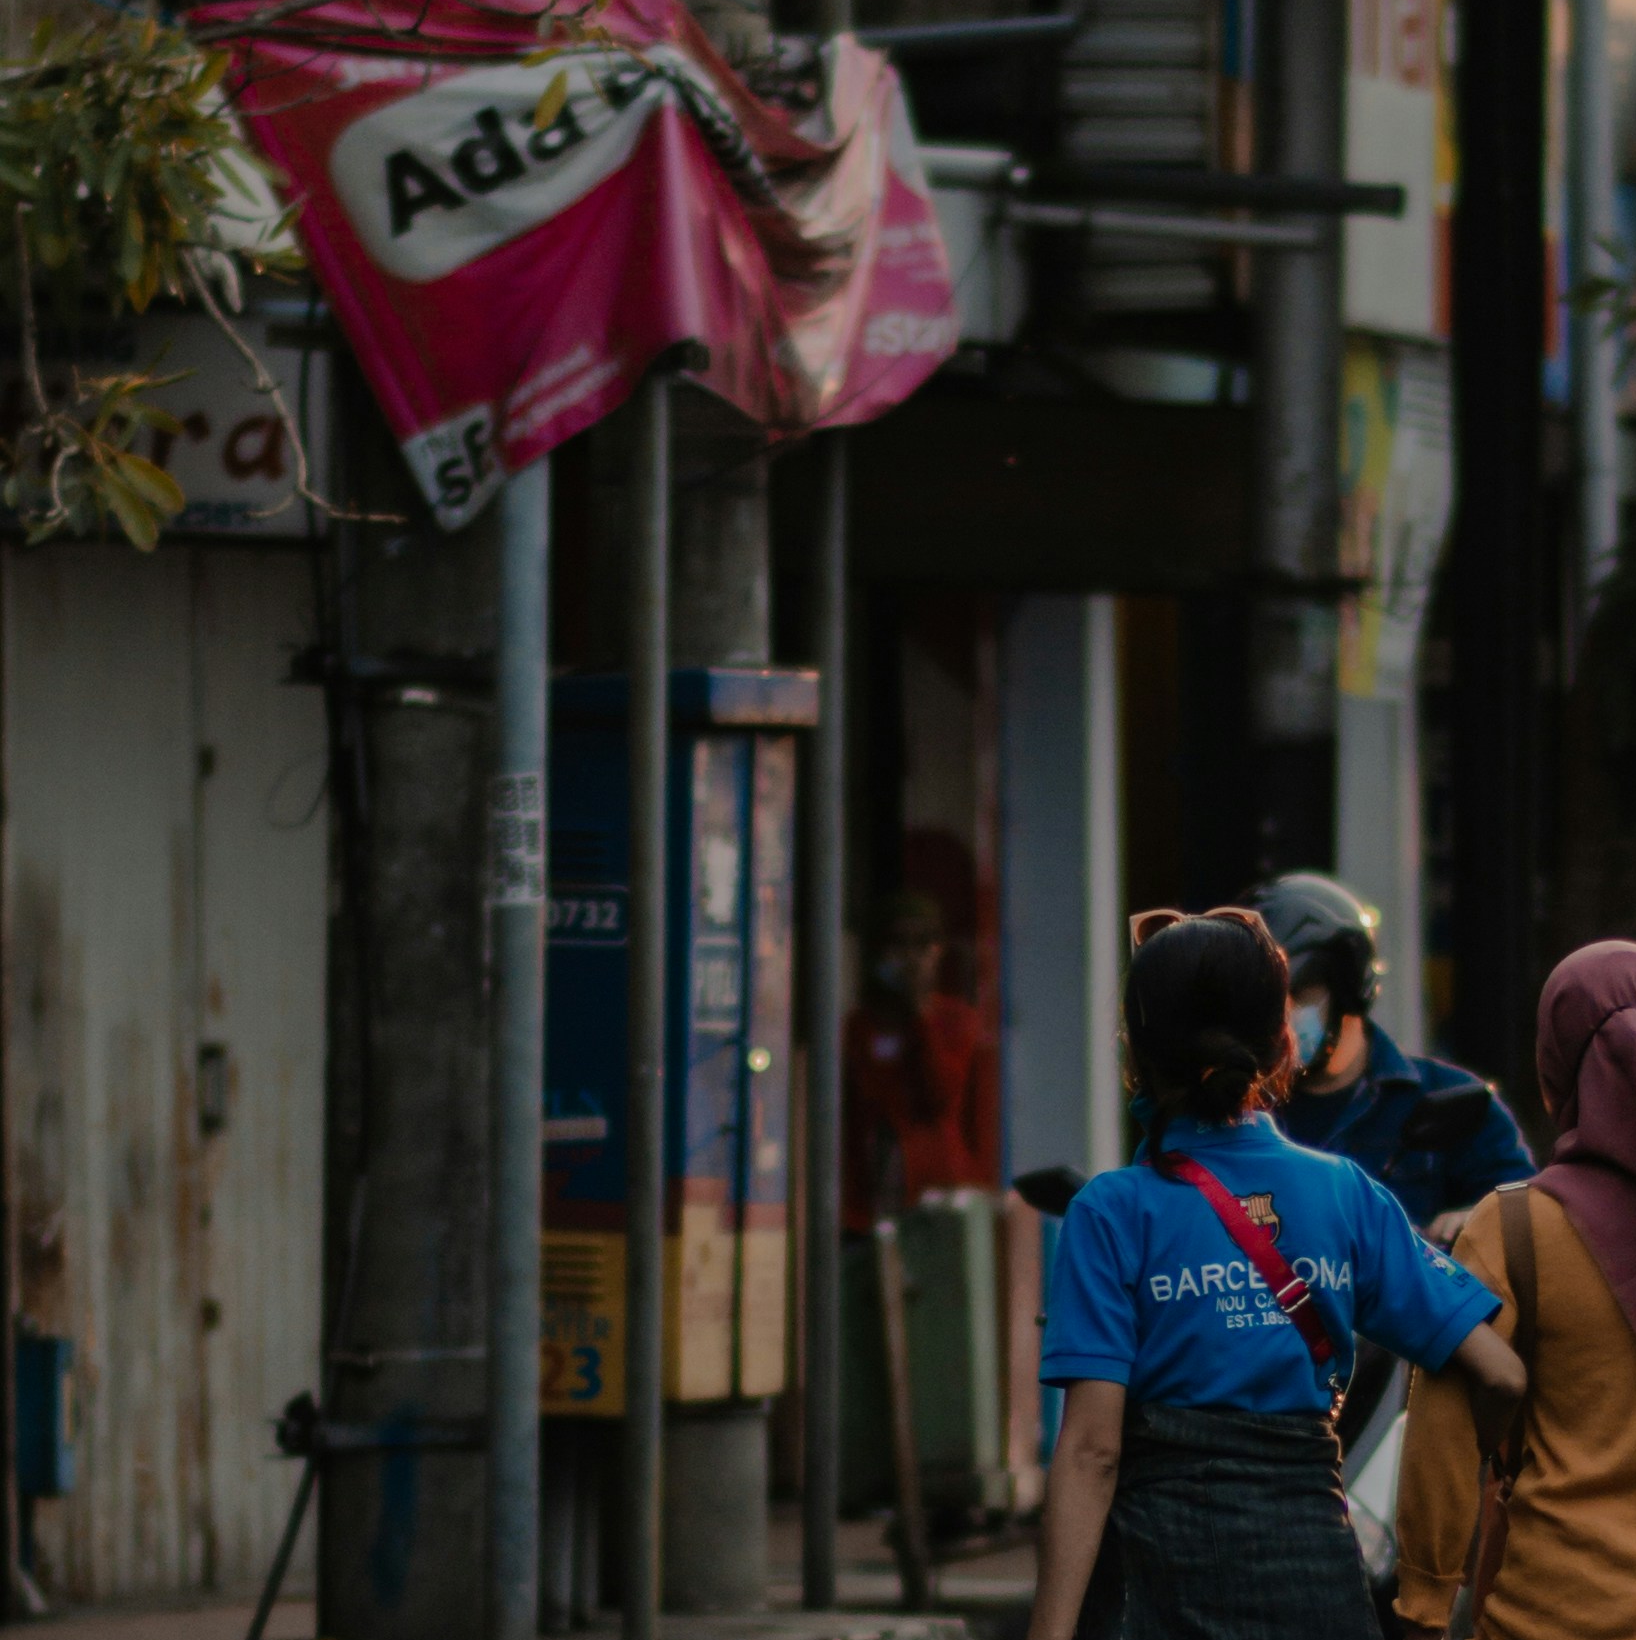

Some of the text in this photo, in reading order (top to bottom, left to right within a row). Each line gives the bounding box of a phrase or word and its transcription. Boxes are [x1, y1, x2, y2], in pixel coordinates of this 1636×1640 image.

[1149, 1256, 1352, 1303] BARCEONA
[1216, 1292, 1278, 1313] NOU CA
